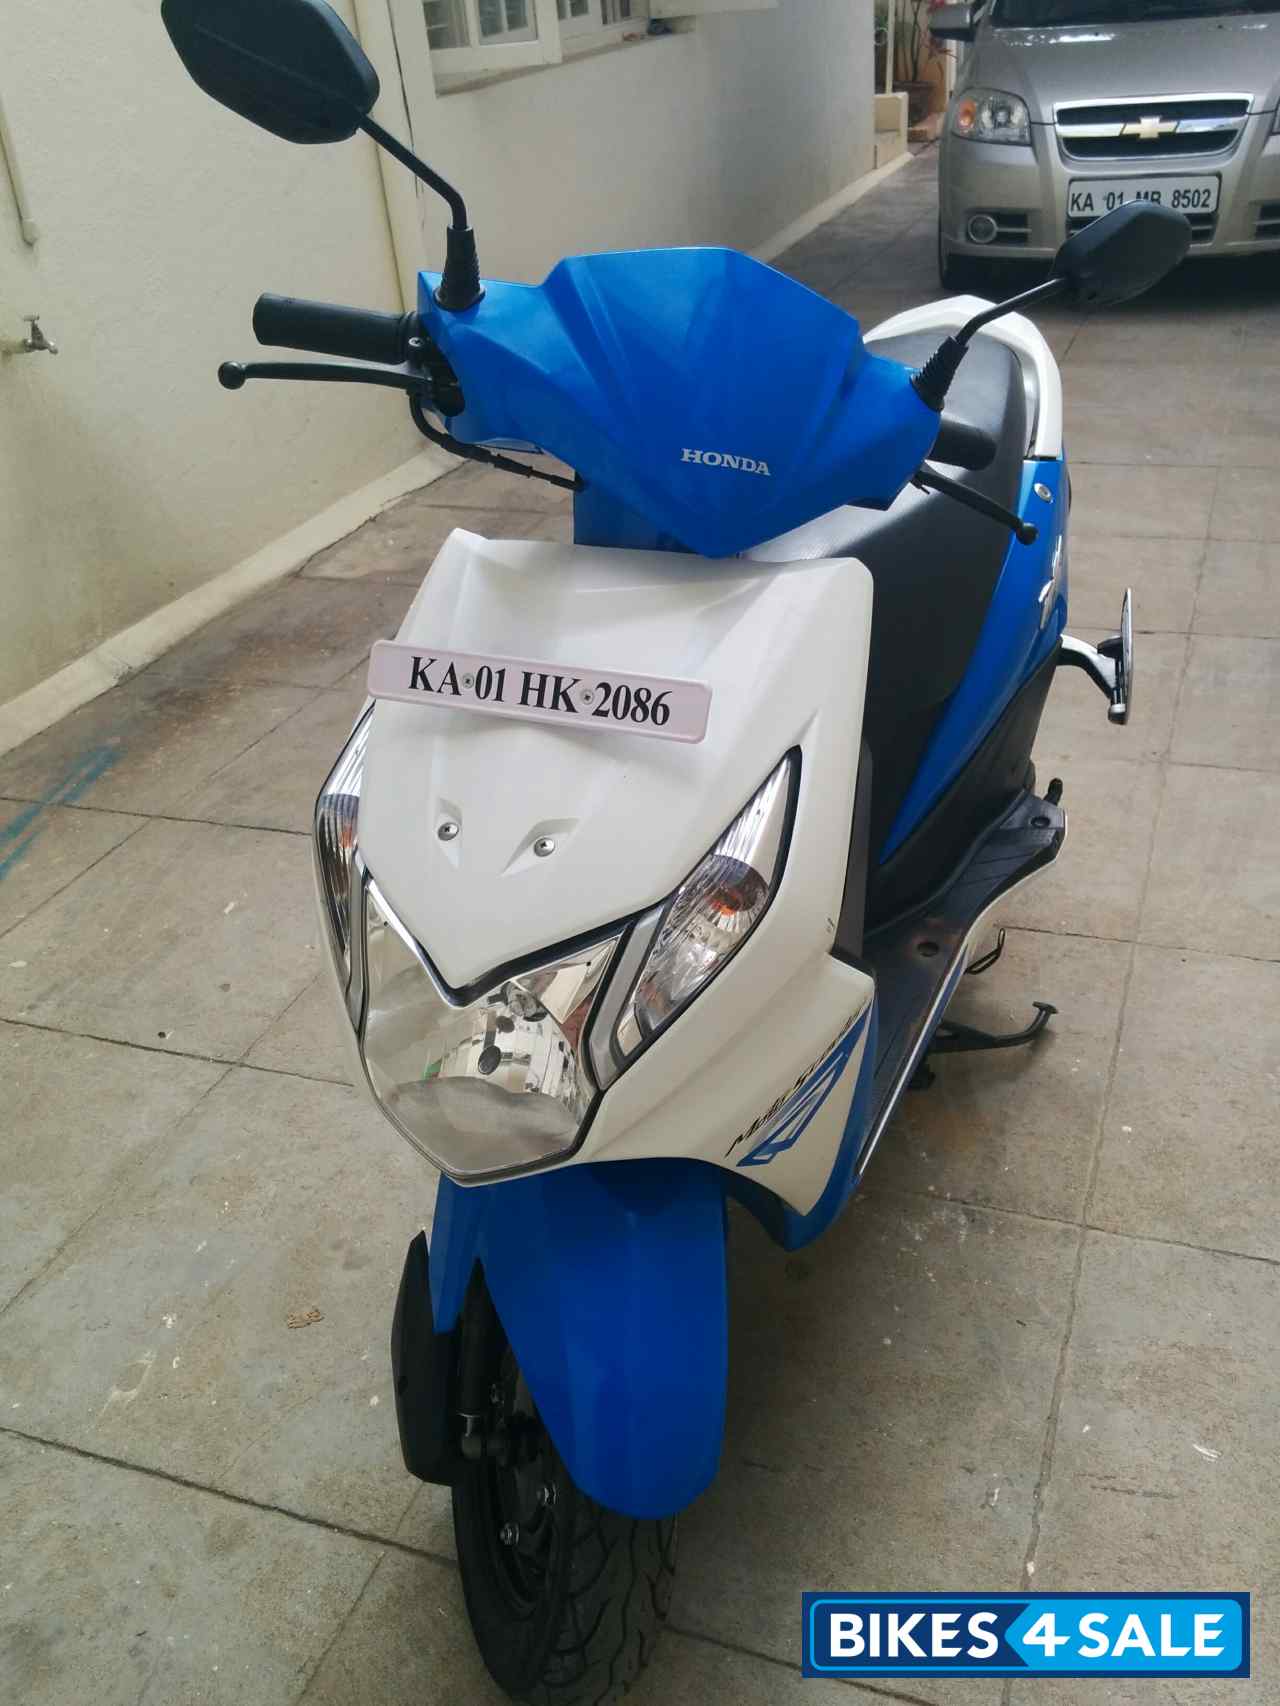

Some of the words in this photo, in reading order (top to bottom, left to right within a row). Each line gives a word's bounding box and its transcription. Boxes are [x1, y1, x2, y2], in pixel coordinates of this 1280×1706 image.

[1070, 193, 1094, 212] KA
[1105, 191, 1124, 211] 01
[1171, 189, 1212, 209] 8502
[680, 448, 771, 476] HONDA
[408, 655, 462, 697] KA
[474, 664, 507, 702] 01
[519, 671, 583, 713] HK
[591, 681, 673, 726] 2086
